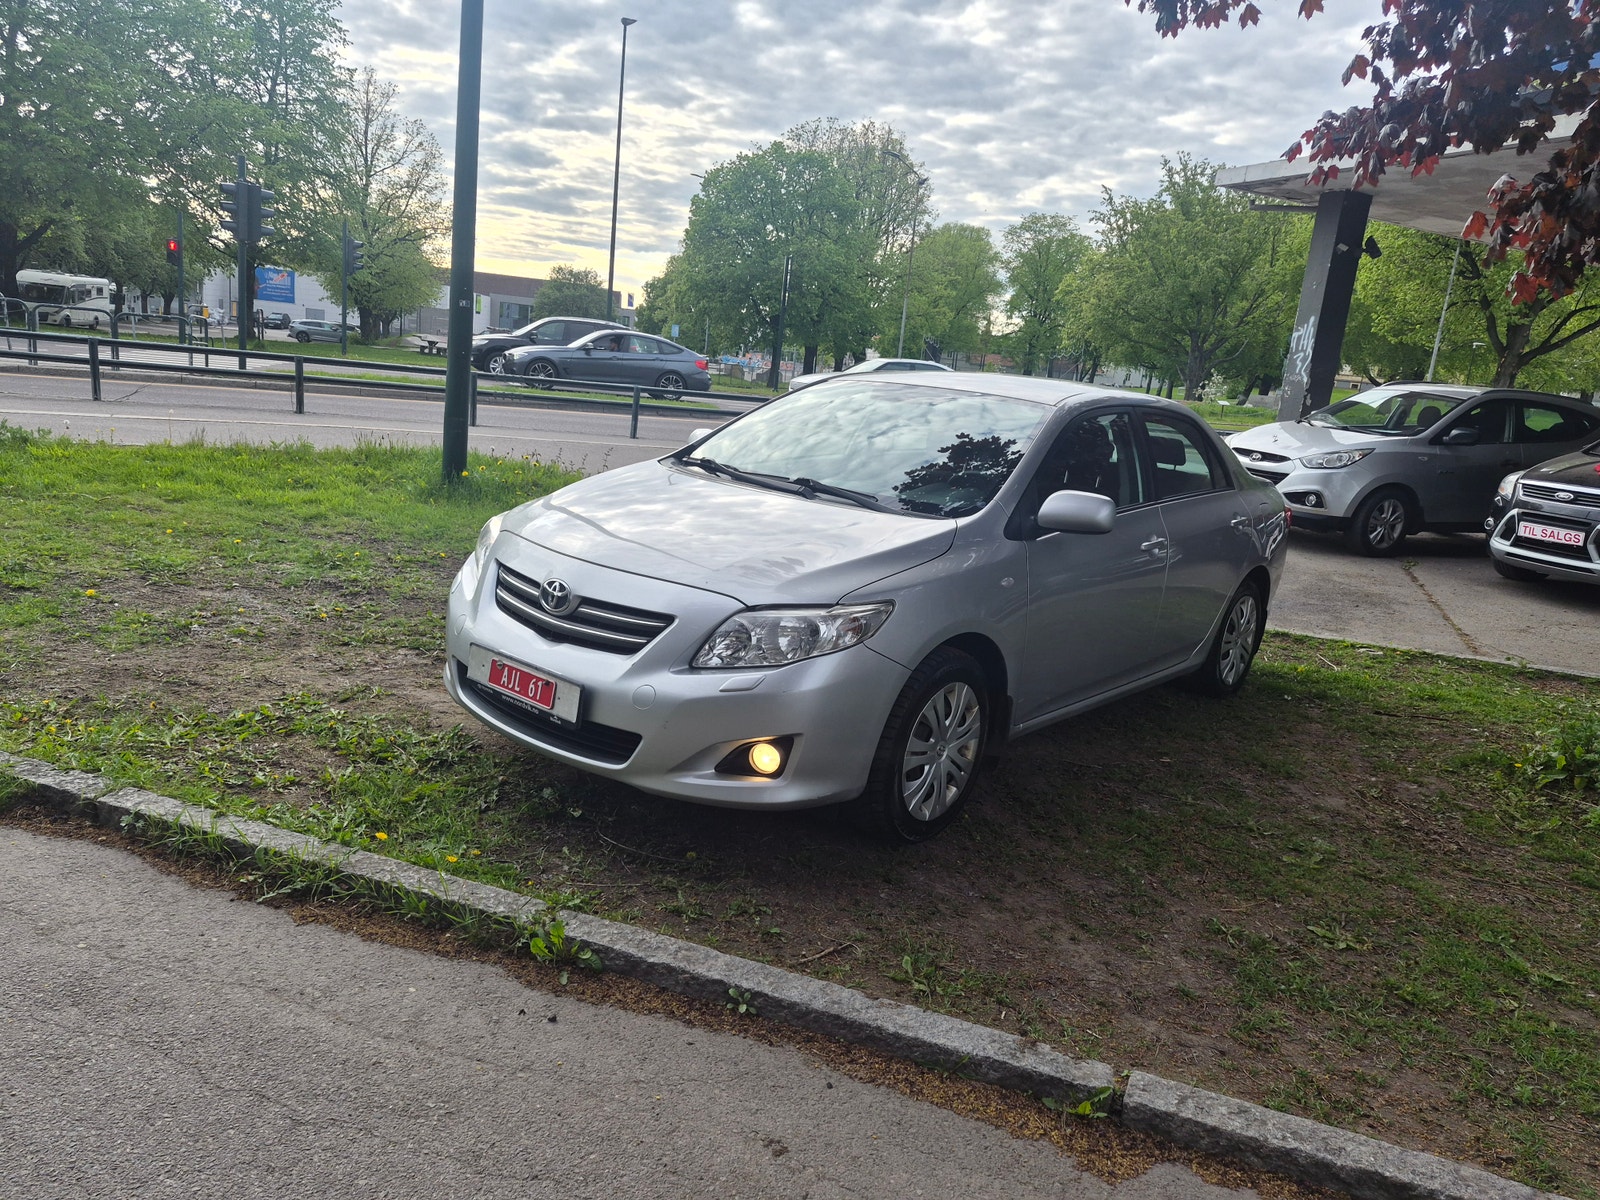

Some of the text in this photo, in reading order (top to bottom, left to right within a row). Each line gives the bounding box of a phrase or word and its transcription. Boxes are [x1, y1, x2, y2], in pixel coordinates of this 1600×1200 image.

[1522, 525, 1581, 544] TIL SALGS
[500, 666, 520, 692] AJL
[528, 678, 544, 700] 61
